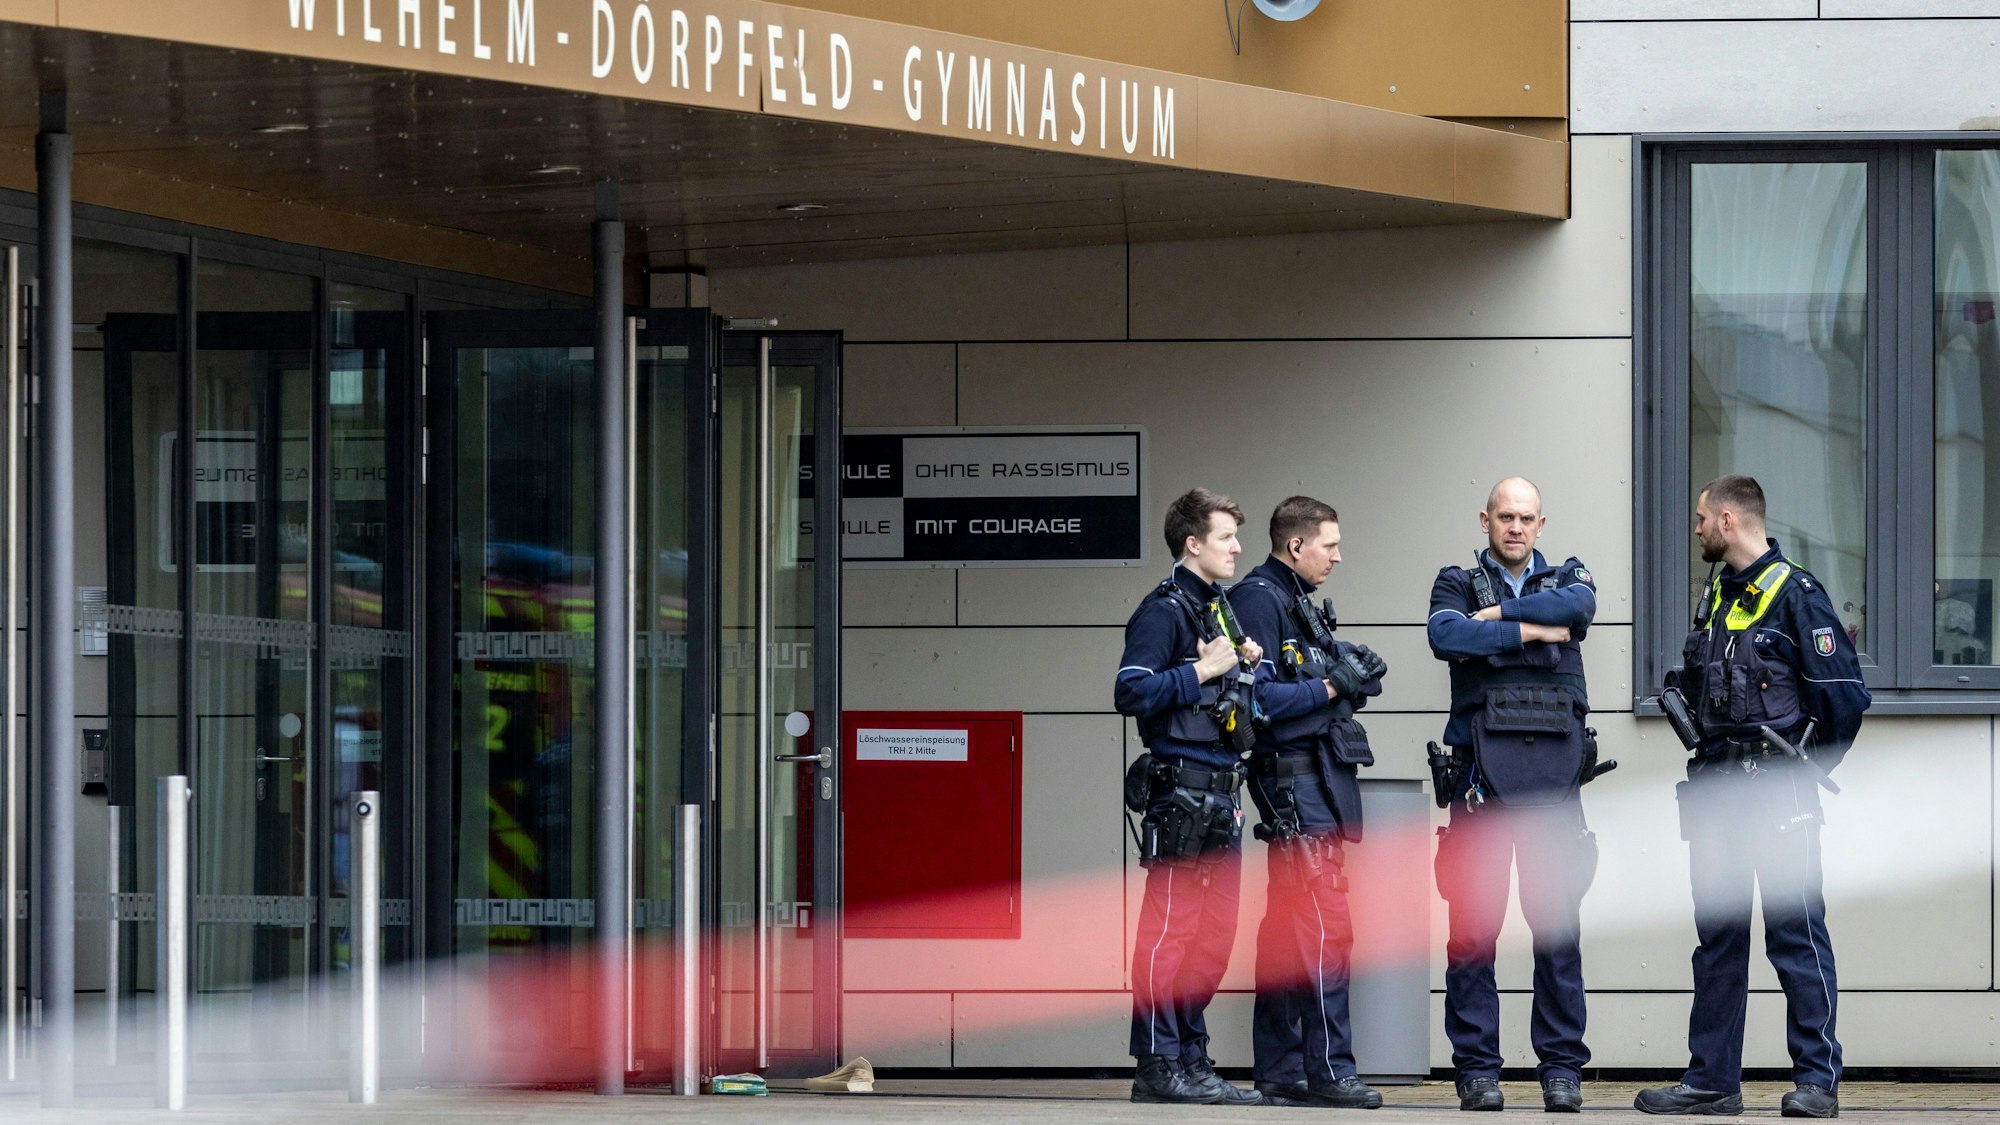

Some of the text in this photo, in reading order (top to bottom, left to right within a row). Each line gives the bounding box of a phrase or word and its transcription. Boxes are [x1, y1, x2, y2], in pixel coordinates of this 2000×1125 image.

[798, 462, 1130, 479] SULE OHNE RASSISMUS
[798, 518, 1081, 535] SULE MIT COURAGE
[859, 735, 966, 746] Löschwassereinspeisung
[888, 746, 936, 755] TRH 2 Mitte
